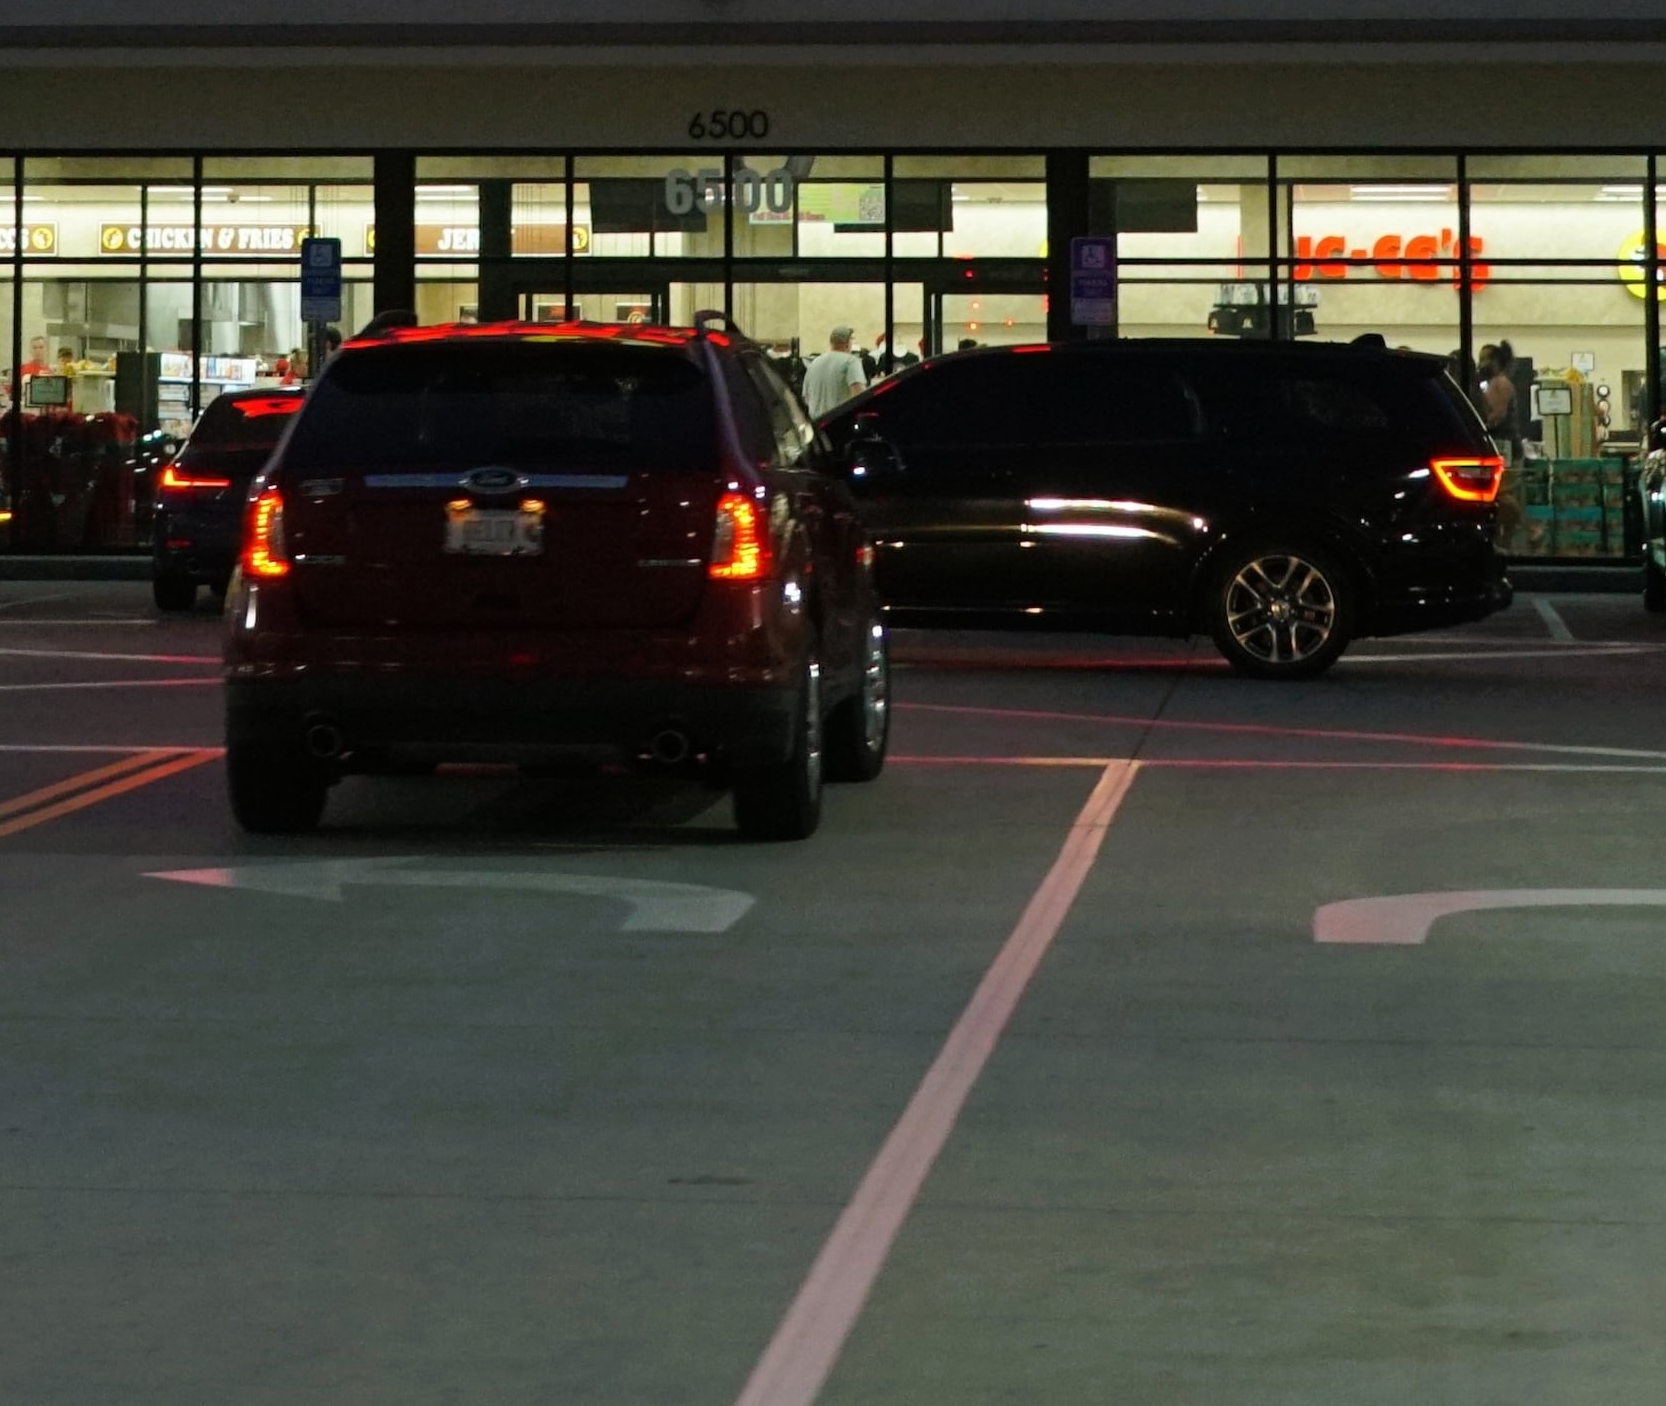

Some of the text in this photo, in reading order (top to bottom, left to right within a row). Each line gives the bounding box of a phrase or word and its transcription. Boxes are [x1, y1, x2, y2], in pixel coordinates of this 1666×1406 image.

[688, 110, 769, 140] 6500
[665, 168, 794, 216] 6500
[127, 227, 214, 250] CHICKN
[238, 228, 294, 250] FRIES
